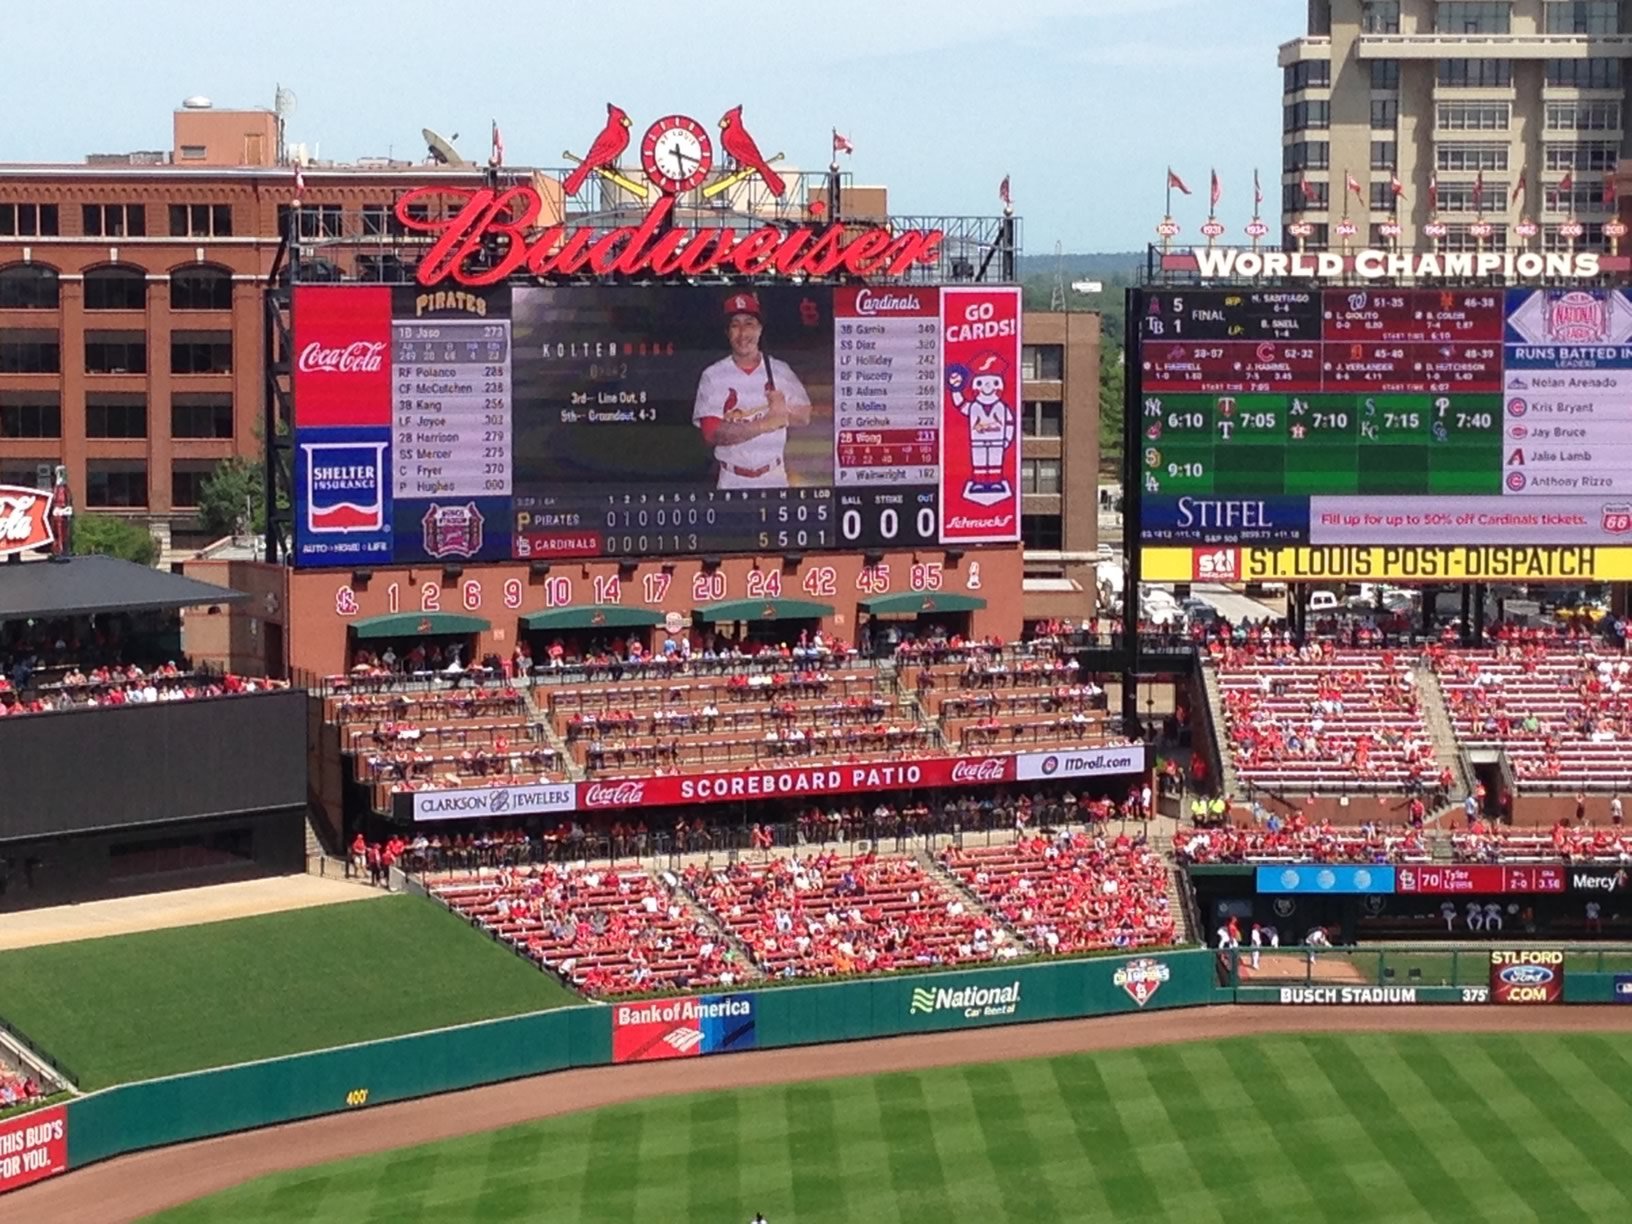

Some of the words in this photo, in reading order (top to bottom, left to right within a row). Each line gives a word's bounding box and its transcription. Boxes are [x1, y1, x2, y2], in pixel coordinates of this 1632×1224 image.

[396, 187, 942, 286] Budweiser
[1195, 249, 1344, 278] WORLD
[1354, 249, 1600, 278] CHAMPIONS
[416, 291, 486, 317] PIRATES
[855, 288, 920, 315] Cardinals
[1173, 297, 1184, 313] 5
[1192, 309, 1225, 321] FINAL
[965, 303, 994, 321] GO
[946, 318, 1016, 342] CARDS!
[1173, 319, 1182, 334] 1
[299, 342, 387, 372] Coca-Cola
[1515, 347, 1555, 360] RUNS
[1560, 347, 1616, 360] BATTED
[856, 356, 893, 367] Holliday
[398, 367, 412, 377] RF
[416, 367, 456, 378] Polanco
[398, 384, 412, 394] CF
[416, 383, 472, 394] McCutchen
[1532, 377, 1566, 388] Nolan
[1569, 377, 1617, 388] Arenado
[416, 400, 442, 412] Kang
[1532, 401, 1553, 412] Kris
[1557, 401, 1594, 414] Bryant
[416, 416, 446, 428] Joyce
[856, 416, 890, 426] Grichuk
[1168, 413, 1204, 429] 6:10
[1240, 413, 1276, 428] 7:05
[1312, 413, 1348, 428] 7:10
[1384, 413, 1420, 428] 7:15
[1456, 413, 1492, 428] 7:40
[416, 431, 460, 443] Harrison
[1532, 428, 1550, 439] Jay
[1554, 426, 1586, 437] Bruce
[416, 448, 452, 459] Mercer
[1560, 450, 1592, 461] Lamb
[313, 465, 375, 480] SHELTER
[416, 465, 442, 478] Fryer
[1168, 463, 1203, 478] 9:10
[313, 479, 375, 491] INSURANCE
[416, 481, 455, 493] Hughes
[1531, 477, 1578, 488] Anthony
[1582, 475, 1613, 487] Rizzo
[841, 496, 862, 505] BALL
[875, 495, 903, 504] STRIKE
[917, 494, 934, 503] OUT
[534, 513, 580, 527] PIRATES
[607, 511, 616, 527] 0
[639, 510, 648, 526] 0
[657, 509, 666, 525] 0
[672, 509, 681, 525] 0
[688, 508, 697, 524] 0
[706, 508, 715, 524] 0
[778, 506, 788, 521] 5
[797, 505, 807, 521] 0
[817, 505, 828, 520] 5
[1177, 496, 1273, 527] STIFEL
[842, 510, 861, 540] 0
[880, 508, 899, 539] 0
[917, 508, 935, 537] 0
[945, 514, 1014, 529] Schnucks
[1321, 513, 1341, 525] Fill
[1344, 514, 1360, 527] up
[1365, 513, 1384, 525] for
[1386, 515, 1403, 527] up
[1407, 513, 1420, 525] to
[1424, 513, 1452, 525] 50%
[1456, 512, 1474, 525] off
[1478, 513, 1538, 526] Cardinals
[1542, 513, 1587, 525] tickets.
[1606, 516, 1628, 529] 66
[303, 544, 328, 553] AUTO
[367, 541, 388, 552] LIFE
[534, 538, 597, 551] CARDINALS
[607, 536, 616, 552] 0
[623, 536, 632, 552] 0
[638, 535, 648, 551] 0
[759, 532, 769, 547] 5
[778, 530, 788, 547] 5
[797, 530, 807, 546] 0
[818, 529, 826, 545] 1
[1199, 549, 1235, 572] stl
[1250, 547, 1287, 576] ST.
[1295, 547, 1372, 576] LOUIS
[1383, 547, 1595, 576] POST-DISPATCH
[388, 583, 399, 613] 1
[421, 582, 440, 612] 2
[463, 580, 481, 610] 6
[504, 578, 522, 608] 9
[545, 576, 571, 607] 10
[594, 574, 621, 604] 14
[643, 573, 671, 602] 17
[693, 570, 727, 600] 20
[747, 568, 781, 598] 24
[803, 566, 837, 596] 42
[856, 564, 890, 594] 45
[910, 562, 943, 592] 85
[951, 758, 1008, 782] Coca-Cola
[681, 770, 841, 798] SCOREBOARD
[853, 765, 921, 787] PATIO
[420, 796, 488, 813] CLARKSON
[512, 790, 570, 809] JEWELERS
[586, 782, 645, 807] Coca-Cola
[1422, 874, 1440, 887] 70
[1444, 869, 1469, 882] Tyler
[1444, 879, 1473, 891] Lyons
[1573, 874, 1617, 891] Mercy
[1492, 951, 1563, 965] STLFORD
[935, 981, 1020, 1009] National
[1280, 988, 1336, 1003] BUSCH
[1341, 988, 1416, 1003] STADIUM
[1507, 987, 1547, 1001] .COM
[619, 1004, 663, 1026] Bank
[663, 1002, 681, 1021] of
[682, 998, 750, 1020] America
[964, 1007, 982, 1018] Car
[984, 1004, 1015, 1016] Rental
[26, 1119, 63, 1149] BUD'S
[23, 1146, 52, 1172] YOU.
